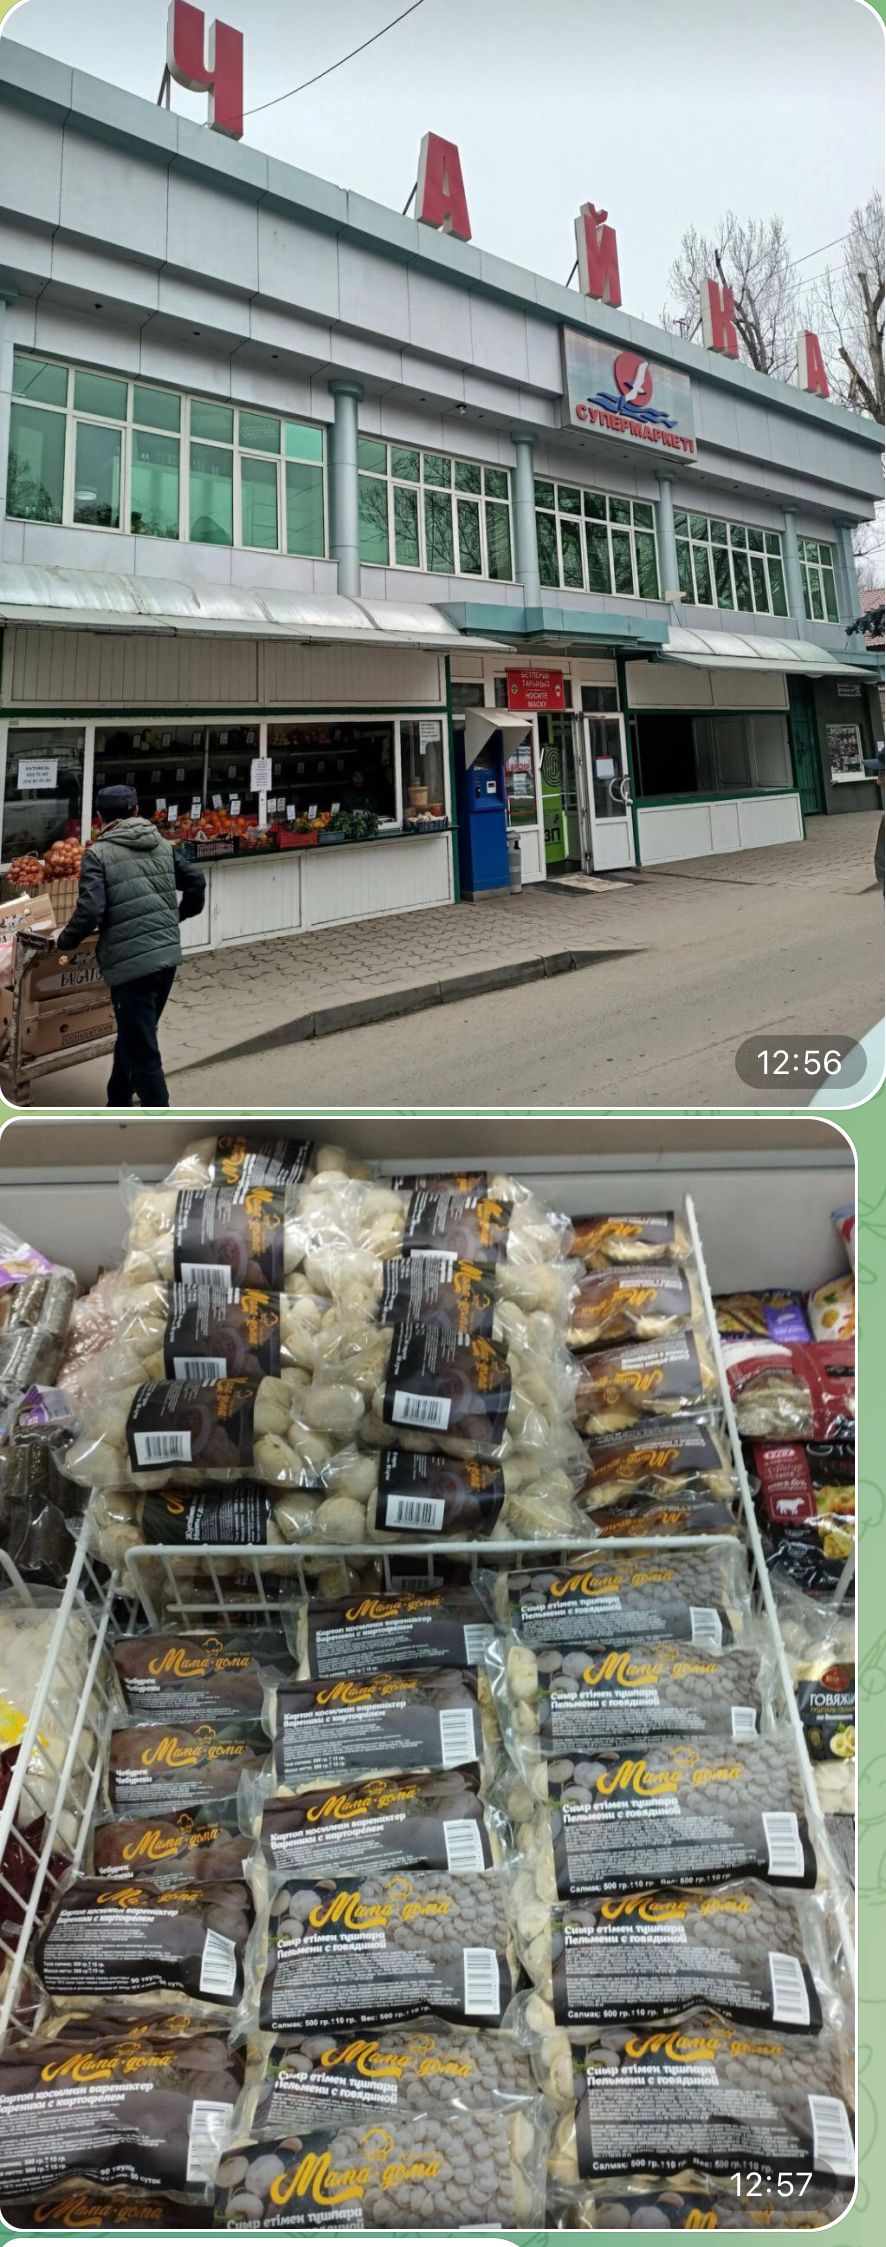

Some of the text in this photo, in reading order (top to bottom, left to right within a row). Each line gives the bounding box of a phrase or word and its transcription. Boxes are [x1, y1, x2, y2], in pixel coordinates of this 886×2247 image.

[41, 2052, 121, 2082] Мама
[89, 2082, 154, 2094] варениктер
[56, 2093, 125, 2107] картофелем
[270, 2151, 370, 2205] Мама
